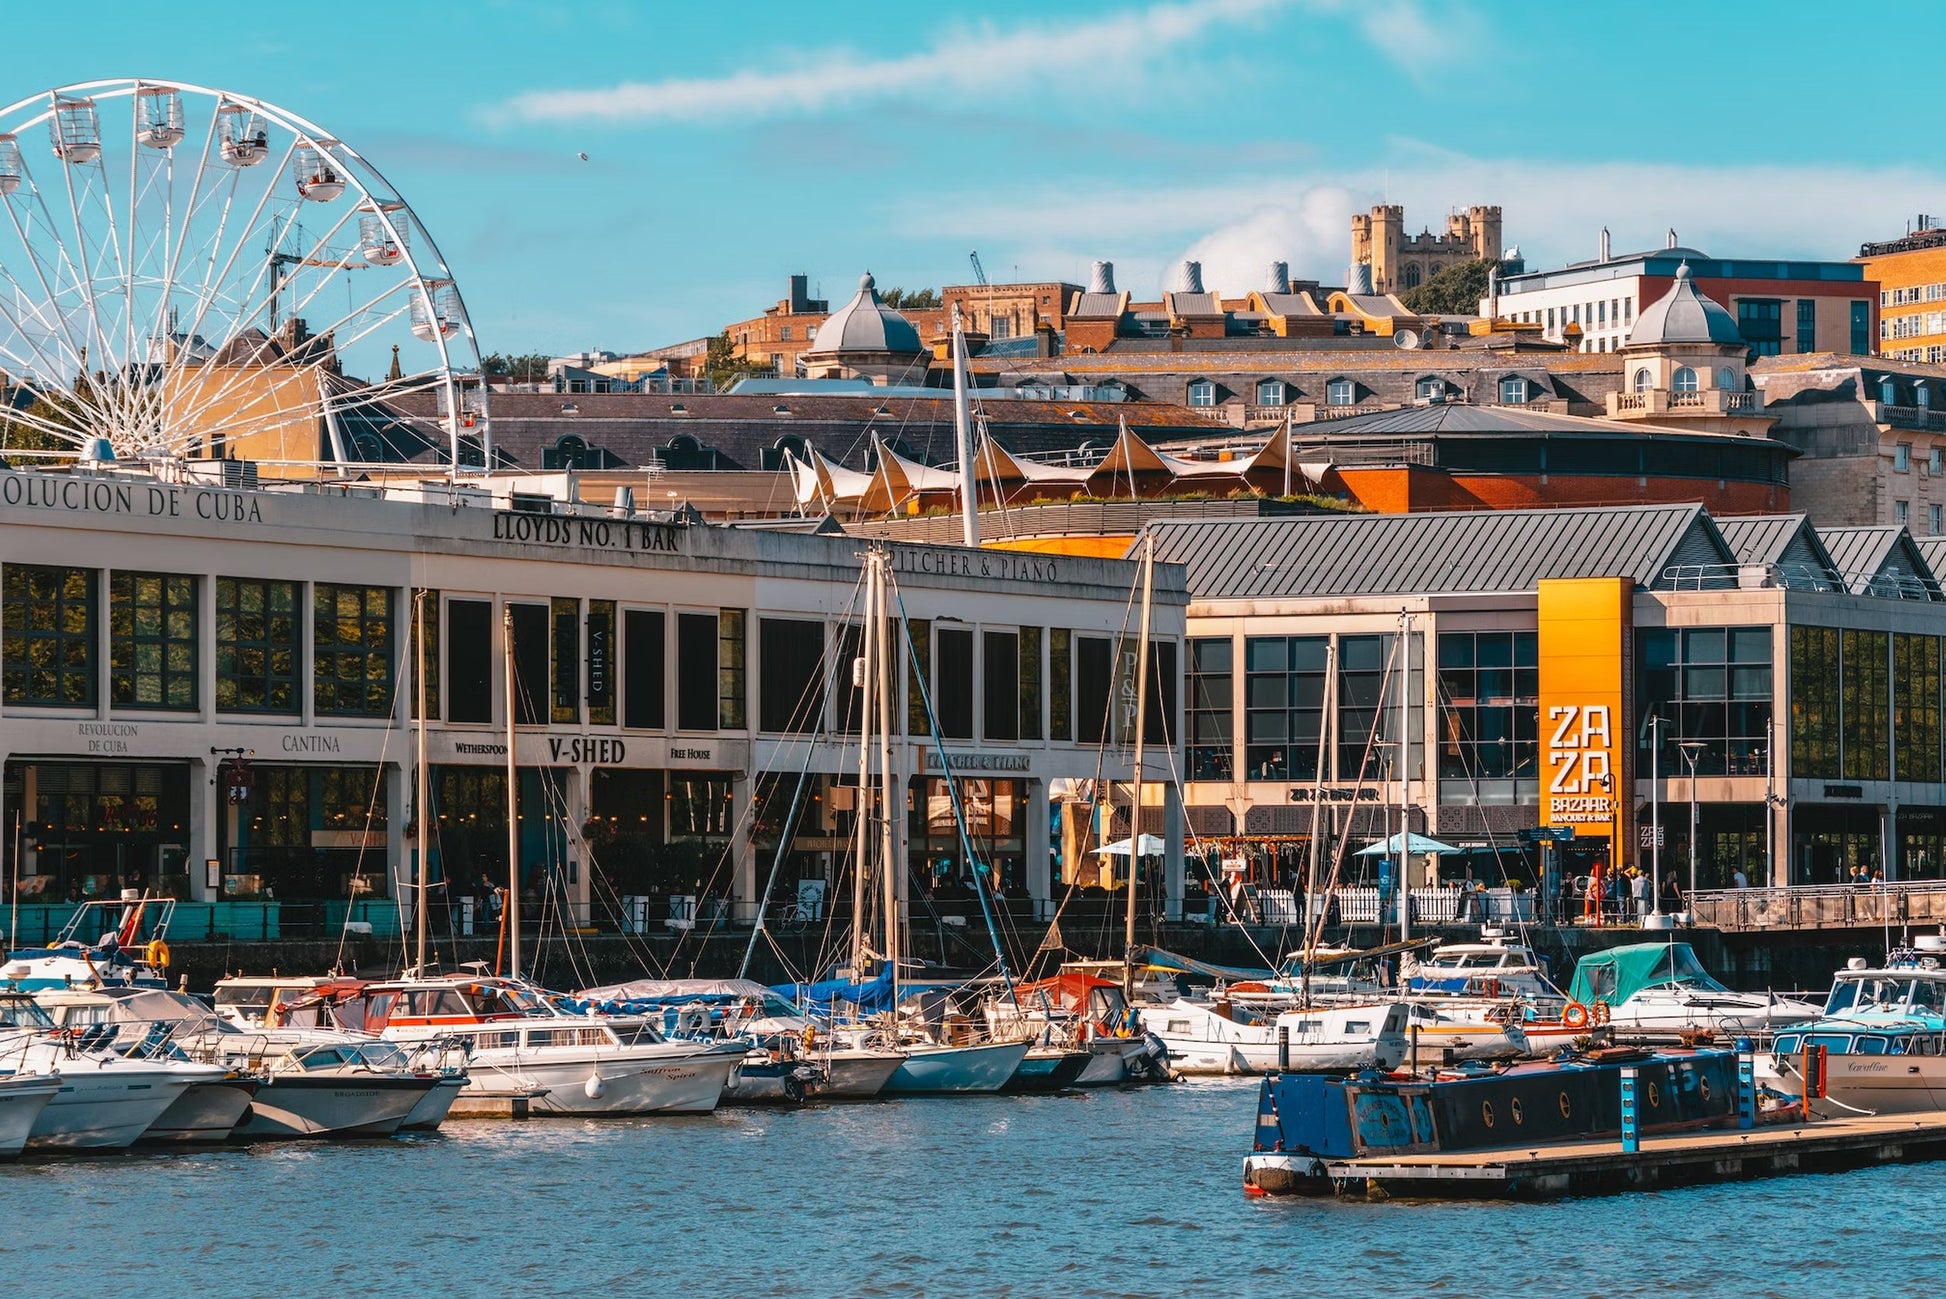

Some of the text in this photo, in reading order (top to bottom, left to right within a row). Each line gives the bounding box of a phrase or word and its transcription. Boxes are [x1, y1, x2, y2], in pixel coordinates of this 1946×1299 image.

[3, 475, 263, 523] OLUCION DE CUBA
[493, 514, 679, 551] LLOYDS NO. 1 BAR
[981, 556, 991, 576] &
[1002, 558, 1057, 582] PIANO
[592, 631, 603, 691] V-SHED
[78, 723, 138, 737] REVOLUCION
[1549, 705, 1611, 748] ZA
[88, 739, 128, 752] DE CUBA
[282, 735, 341, 753] CANTINA
[548, 738, 626, 763] V-SHED
[670, 748, 711, 760] FREE HOUSE
[1549, 751, 1611, 793] ZA
[1550, 797, 1611, 812] BAZAAR
[1595, 814, 1611, 823] BAR
[666, 1072, 697, 1081] Spirit
